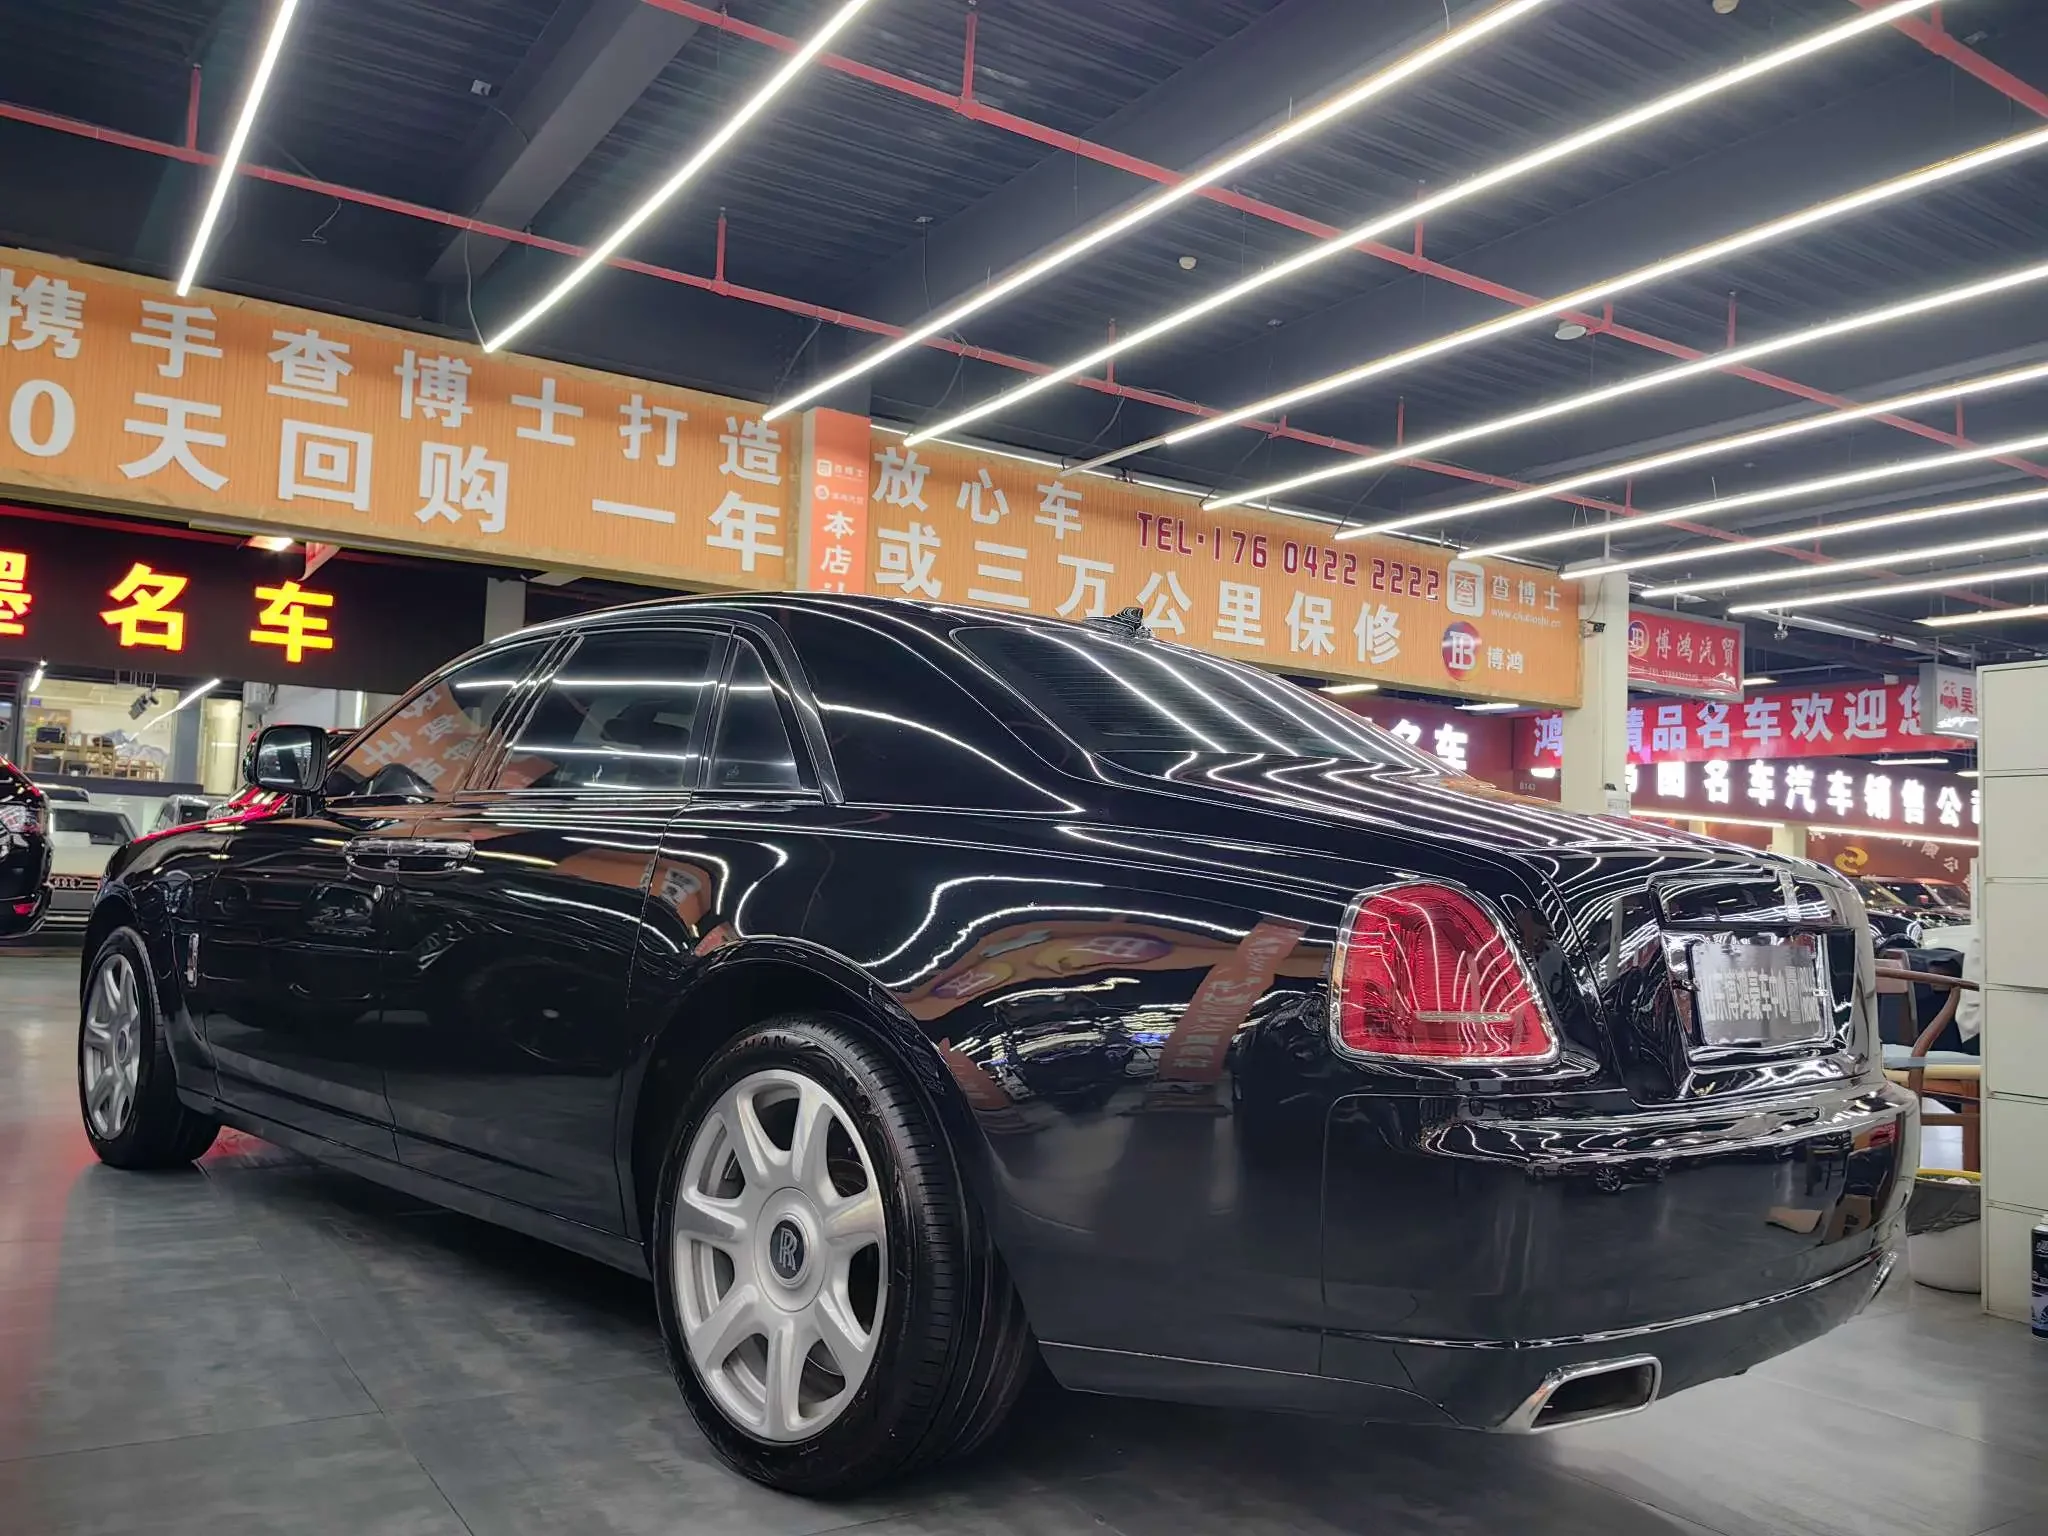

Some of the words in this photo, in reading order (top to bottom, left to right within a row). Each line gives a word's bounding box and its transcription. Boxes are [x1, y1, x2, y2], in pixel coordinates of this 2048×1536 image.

[0, 268, 783, 485] 携手查博士打造
[871, 447, 1084, 540] 放心车
[874, 521, 1402, 665] 或三万公里保修
[1283, 541, 1358, 587] 0422
[1371, 557, 1440, 601] 2222
[1491, 576, 1562, 612] 查博士
[1486, 646, 1524, 675] 博鸿
